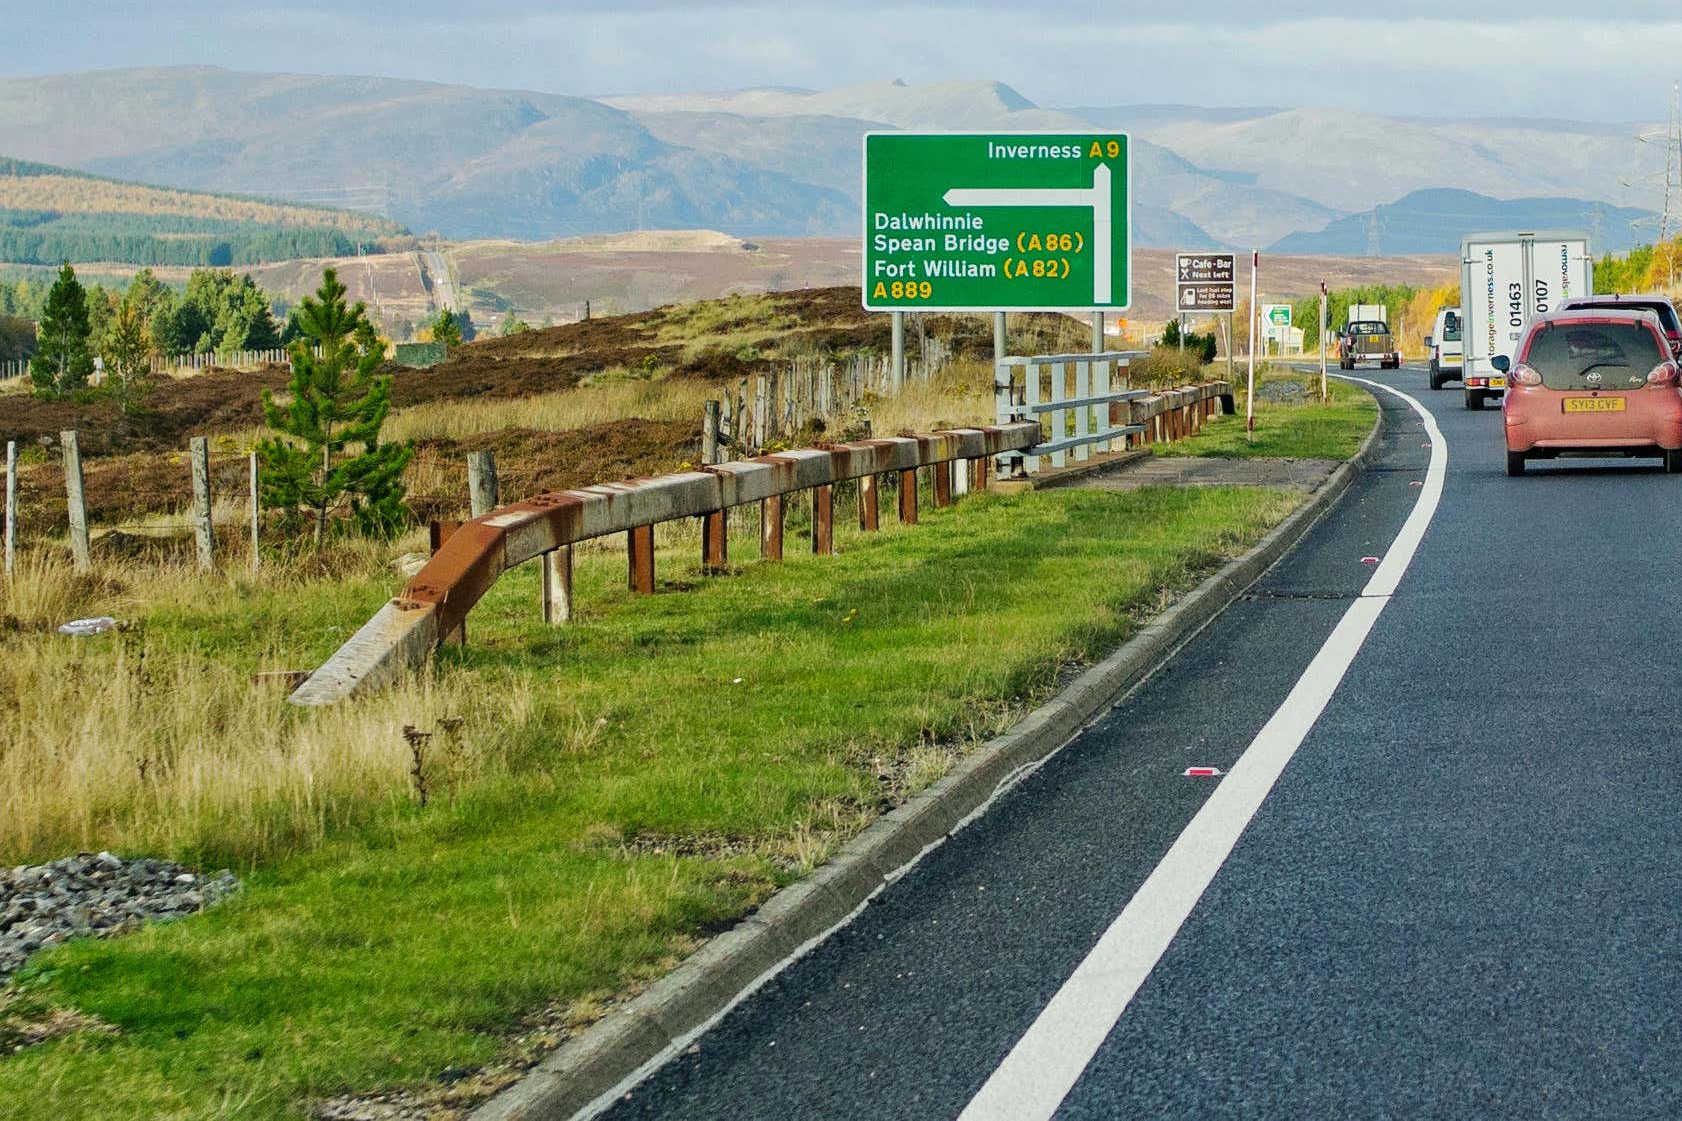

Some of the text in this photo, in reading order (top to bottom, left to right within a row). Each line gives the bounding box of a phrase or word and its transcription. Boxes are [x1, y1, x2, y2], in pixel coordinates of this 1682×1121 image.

[989, 141, 1120, 159] Inverness A9
[875, 213, 984, 230] Dalwhinnie
[874, 231, 1084, 255] Spean Bridge (A86)
[875, 258, 1070, 279] Fort William (A82)
[873, 281, 932, 298] A889
[1485, 249, 1497, 360] torageinverness.co.uk
[1509, 283, 1522, 327] 01463
[1571, 399, 1595, 410] SY13
